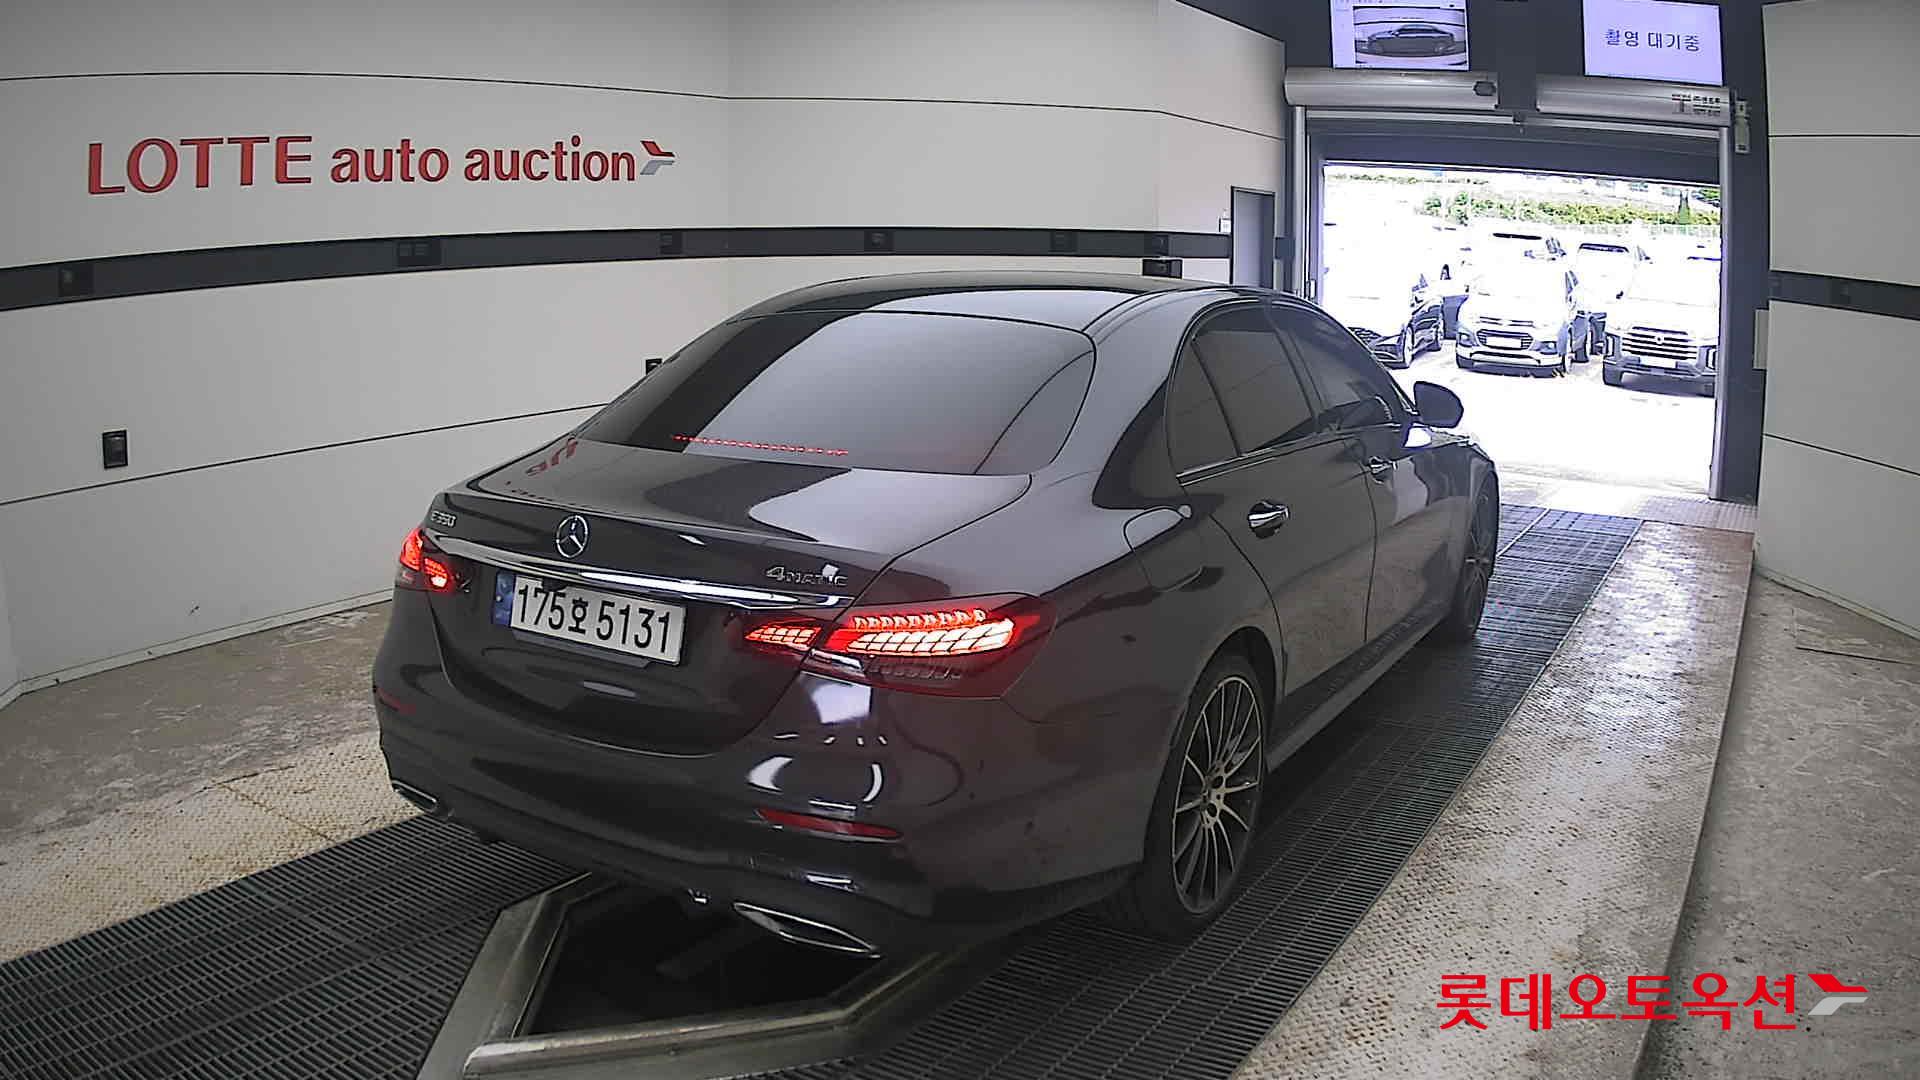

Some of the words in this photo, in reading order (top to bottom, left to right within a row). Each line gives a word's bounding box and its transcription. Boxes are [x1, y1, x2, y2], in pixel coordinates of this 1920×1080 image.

[1647, 32, 1700, 52] 대기중
[87, 135, 312, 195] LOTTE
[330, 138, 449, 183] auto
[463, 135, 636, 182] auction
[596, 600, 671, 654] 5131
